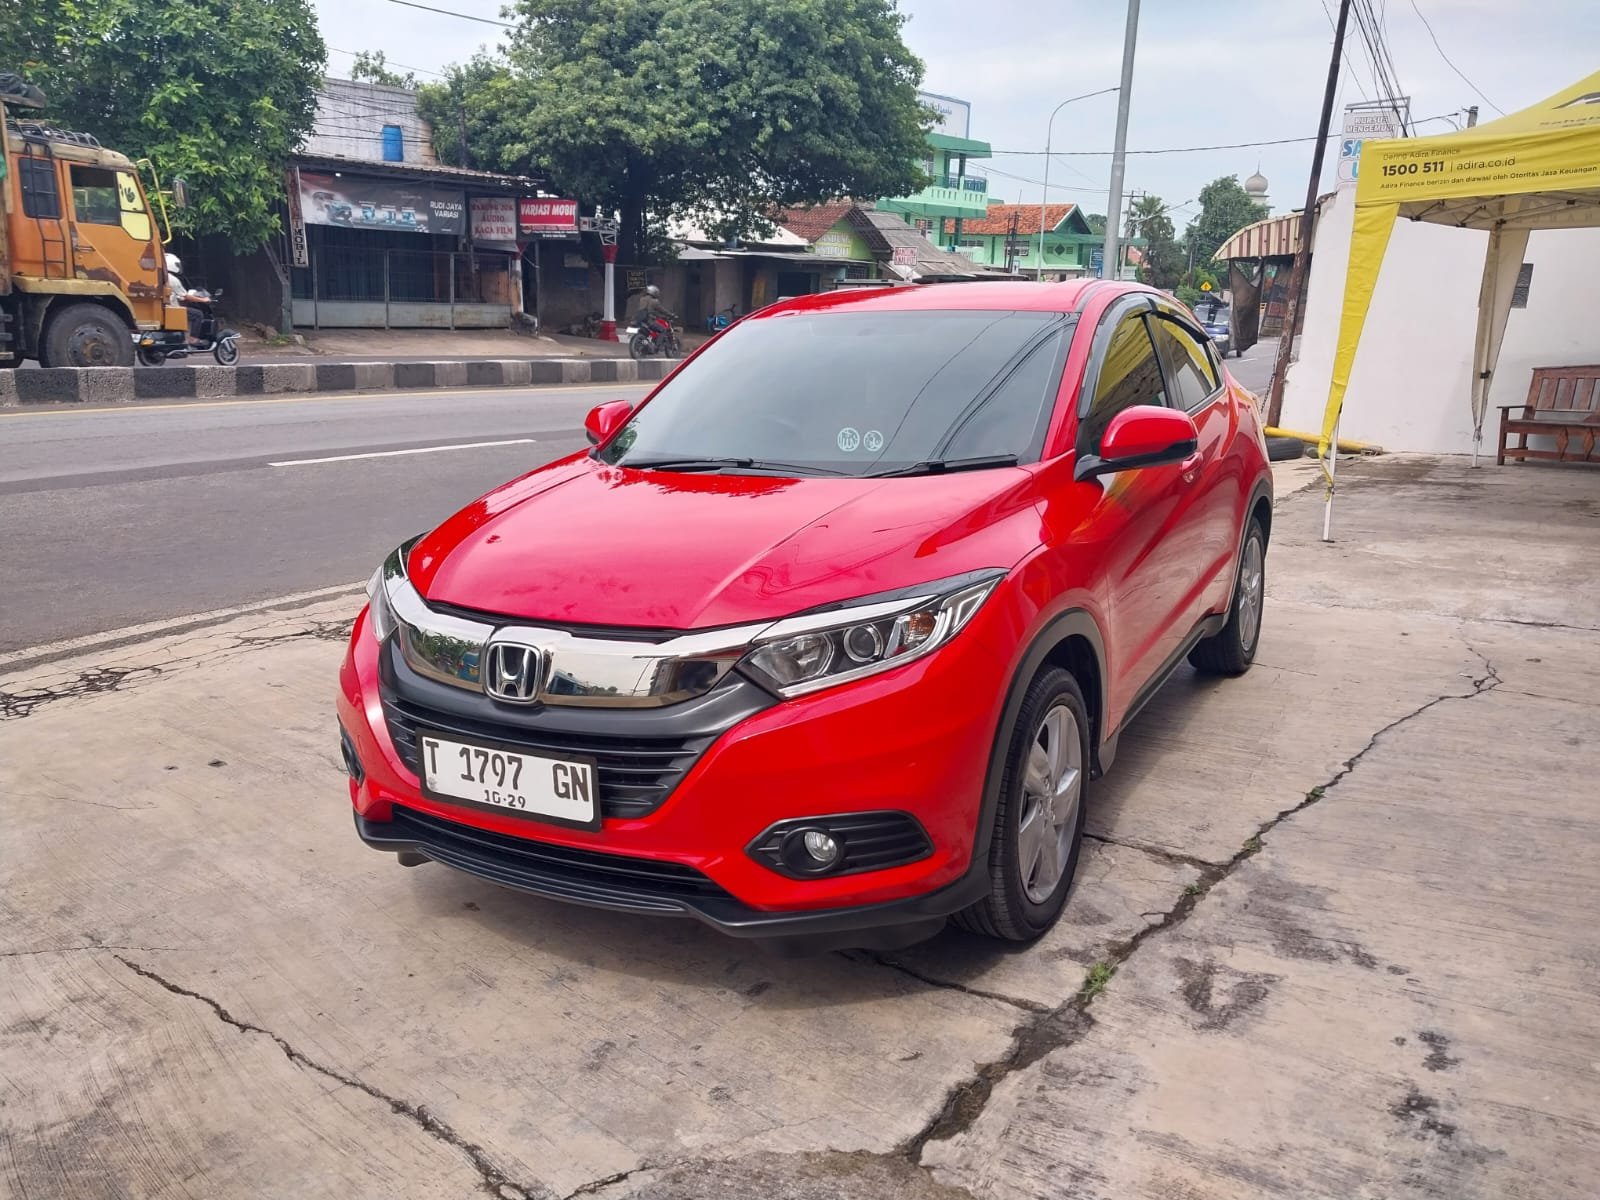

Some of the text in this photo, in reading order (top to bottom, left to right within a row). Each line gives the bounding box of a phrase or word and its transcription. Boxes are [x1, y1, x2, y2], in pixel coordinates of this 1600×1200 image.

[1382, 156, 1516, 176] 1500 511 adira.co.id
[1399, 180, 1425, 188] Finance
[1426, 178, 1450, 186] berizin
[1465, 174, 1491, 183] diawasi
[1492, 173, 1508, 181] oleh
[1510, 171, 1539, 179] Otoritas
[1540, 169, 1558, 177] Jasa
[1559, 166, 1597, 175] Keuangan
[430, 201, 445, 209] RUDI
[520, 203, 550, 216] VARIASI
[434, 209, 459, 219] VARIASI
[481, 214, 505, 222] AUDIO
[496, 226, 513, 234] FILM
[425, 740, 590, 802] T 1797 GN
